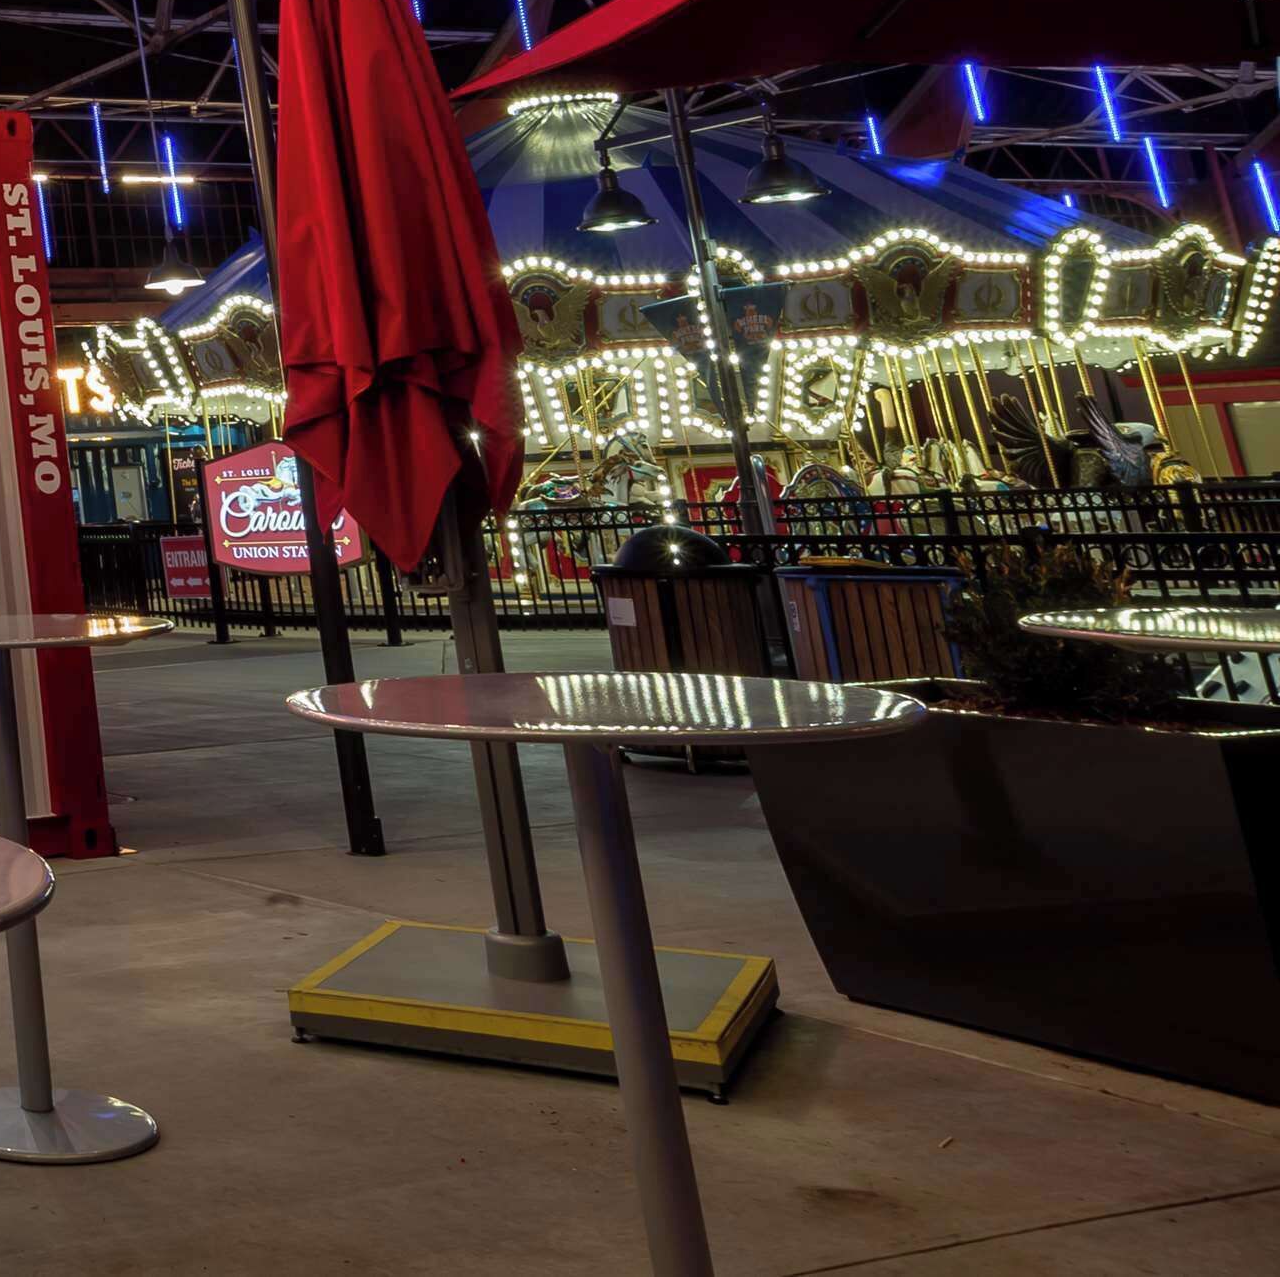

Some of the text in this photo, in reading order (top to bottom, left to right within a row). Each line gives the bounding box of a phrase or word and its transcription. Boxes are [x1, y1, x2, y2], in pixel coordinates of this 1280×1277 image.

[2, 182, 61, 495] ST. LOUIS, MO
[241, 468, 271, 477] LOUIS
[220, 491, 344, 537] Carou
[165, 550, 208, 568] ENTRAN
[232, 544, 343, 559] UNION STAN
